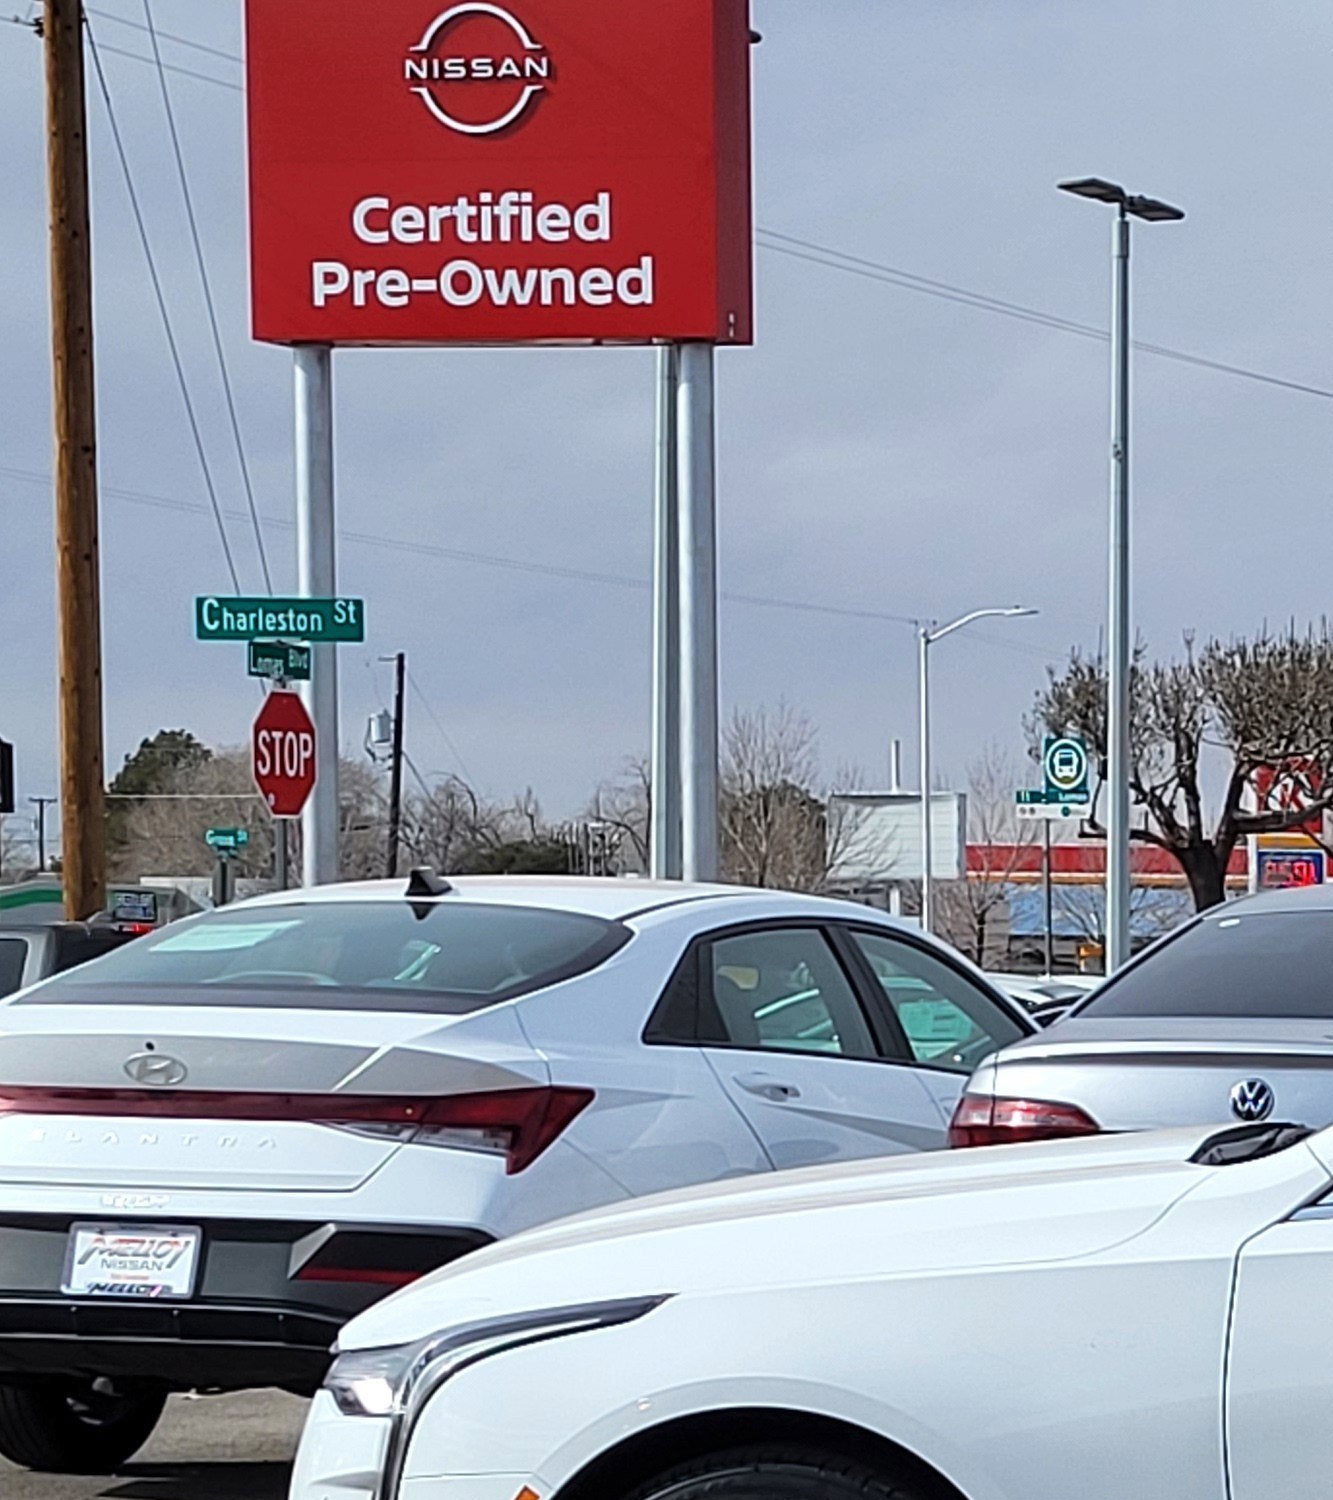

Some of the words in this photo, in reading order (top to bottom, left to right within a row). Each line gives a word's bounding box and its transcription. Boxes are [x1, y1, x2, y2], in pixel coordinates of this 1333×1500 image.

[404, 56, 549, 80] NISSAN
[352, 192, 611, 244] Certified
[311, 256, 654, 308] Pre-Owned
[202, 598, 323, 632] Charleston
[334, 600, 357, 624] St
[257, 729, 313, 778] STOP
[101, 1258, 164, 1270] NISSAN
